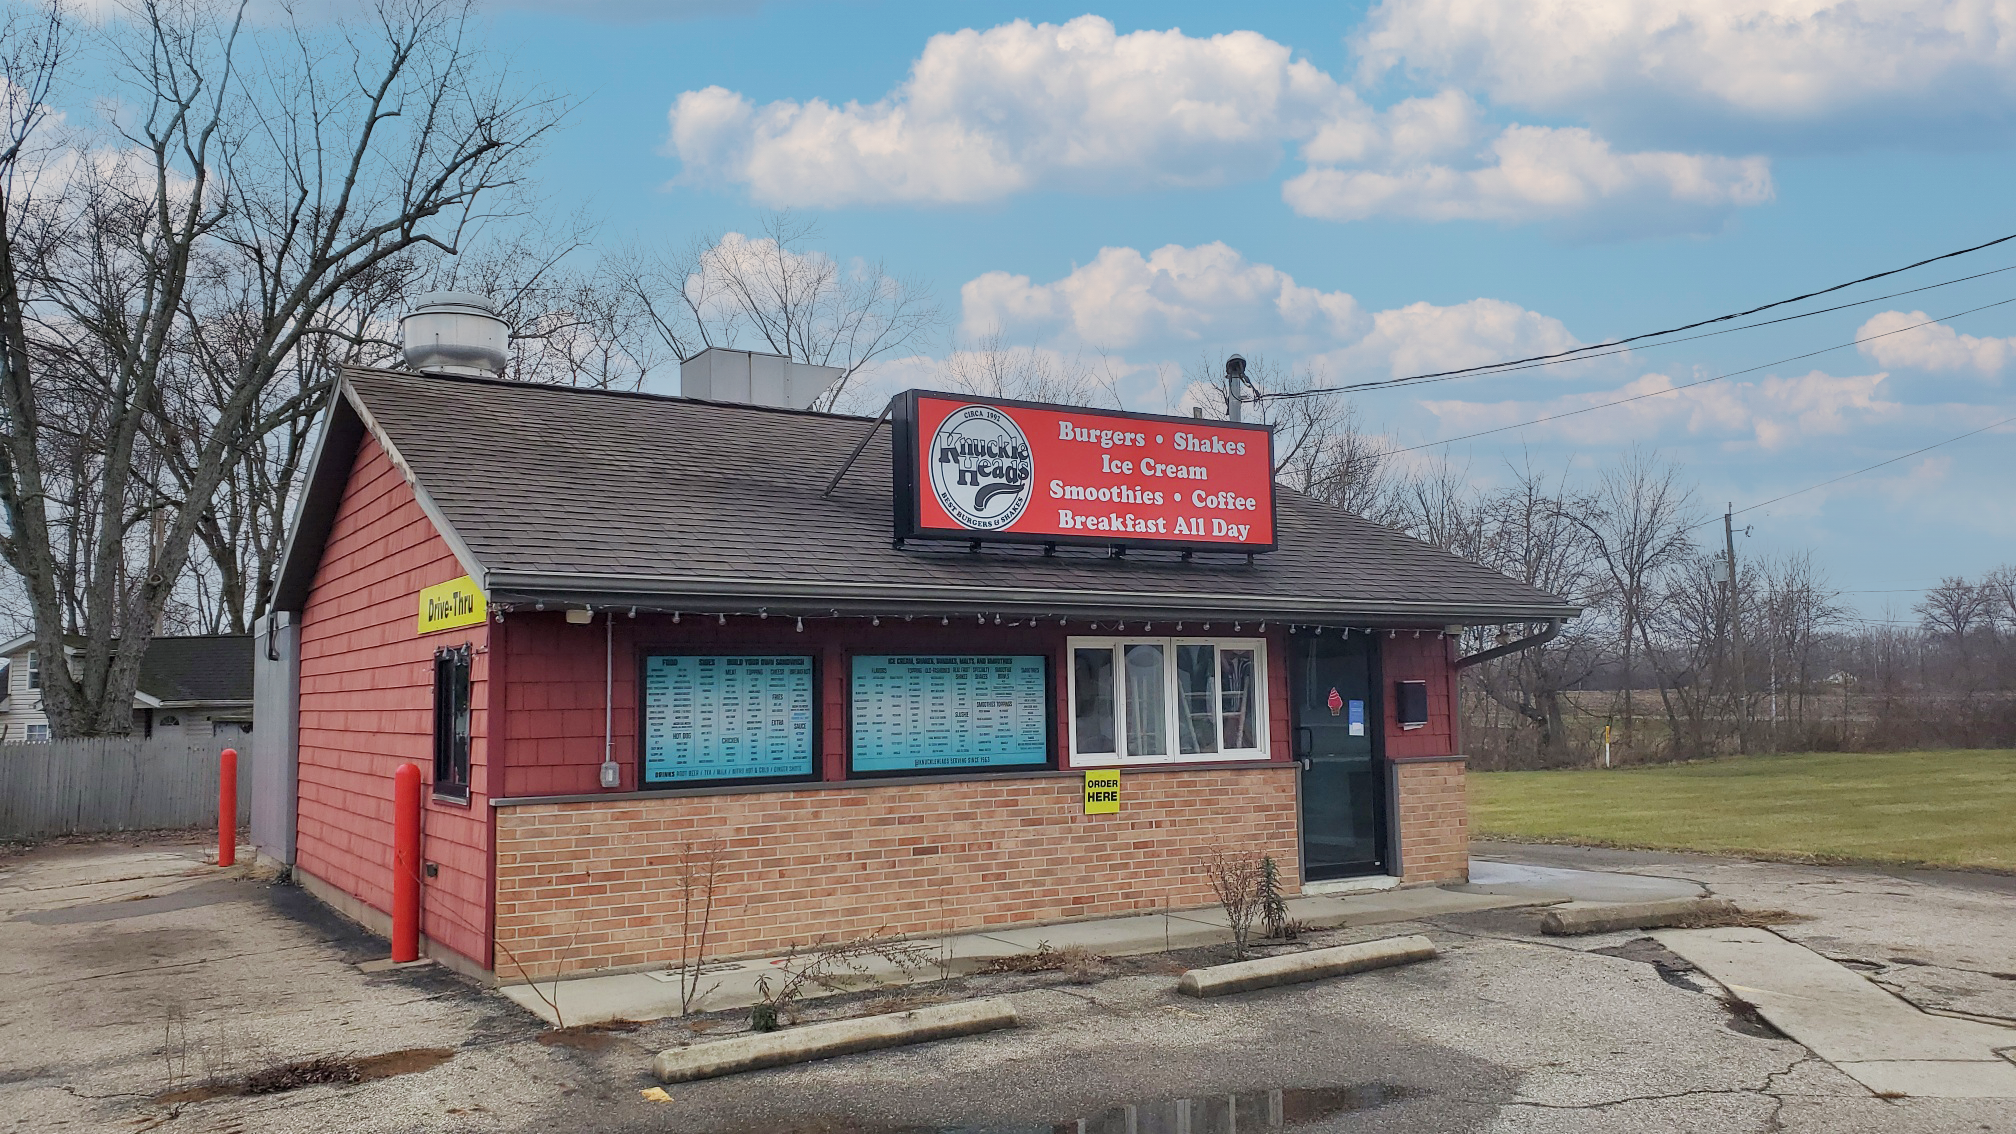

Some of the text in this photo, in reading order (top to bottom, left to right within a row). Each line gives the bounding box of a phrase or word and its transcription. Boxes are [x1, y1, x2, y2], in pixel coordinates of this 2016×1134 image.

[987, 412, 1001, 422] 1992
[938, 432, 1029, 463] Knuckle
[1058, 421, 1246, 456] Burgers Shakes
[958, 456, 1029, 486] Heads
[1102, 455, 1207, 480] Ice Cream
[941, 492, 957, 512] BEST
[957, 511, 992, 527] BURGERS
[1001, 497, 1023, 523] SHAKES
[1049, 480, 1256, 511] Smoothies Coffee
[1058, 509, 1251, 541] Breakfast All Day
[428, 591, 473, 622] Drive-Thru
[1088, 791, 1117, 802] HERE
